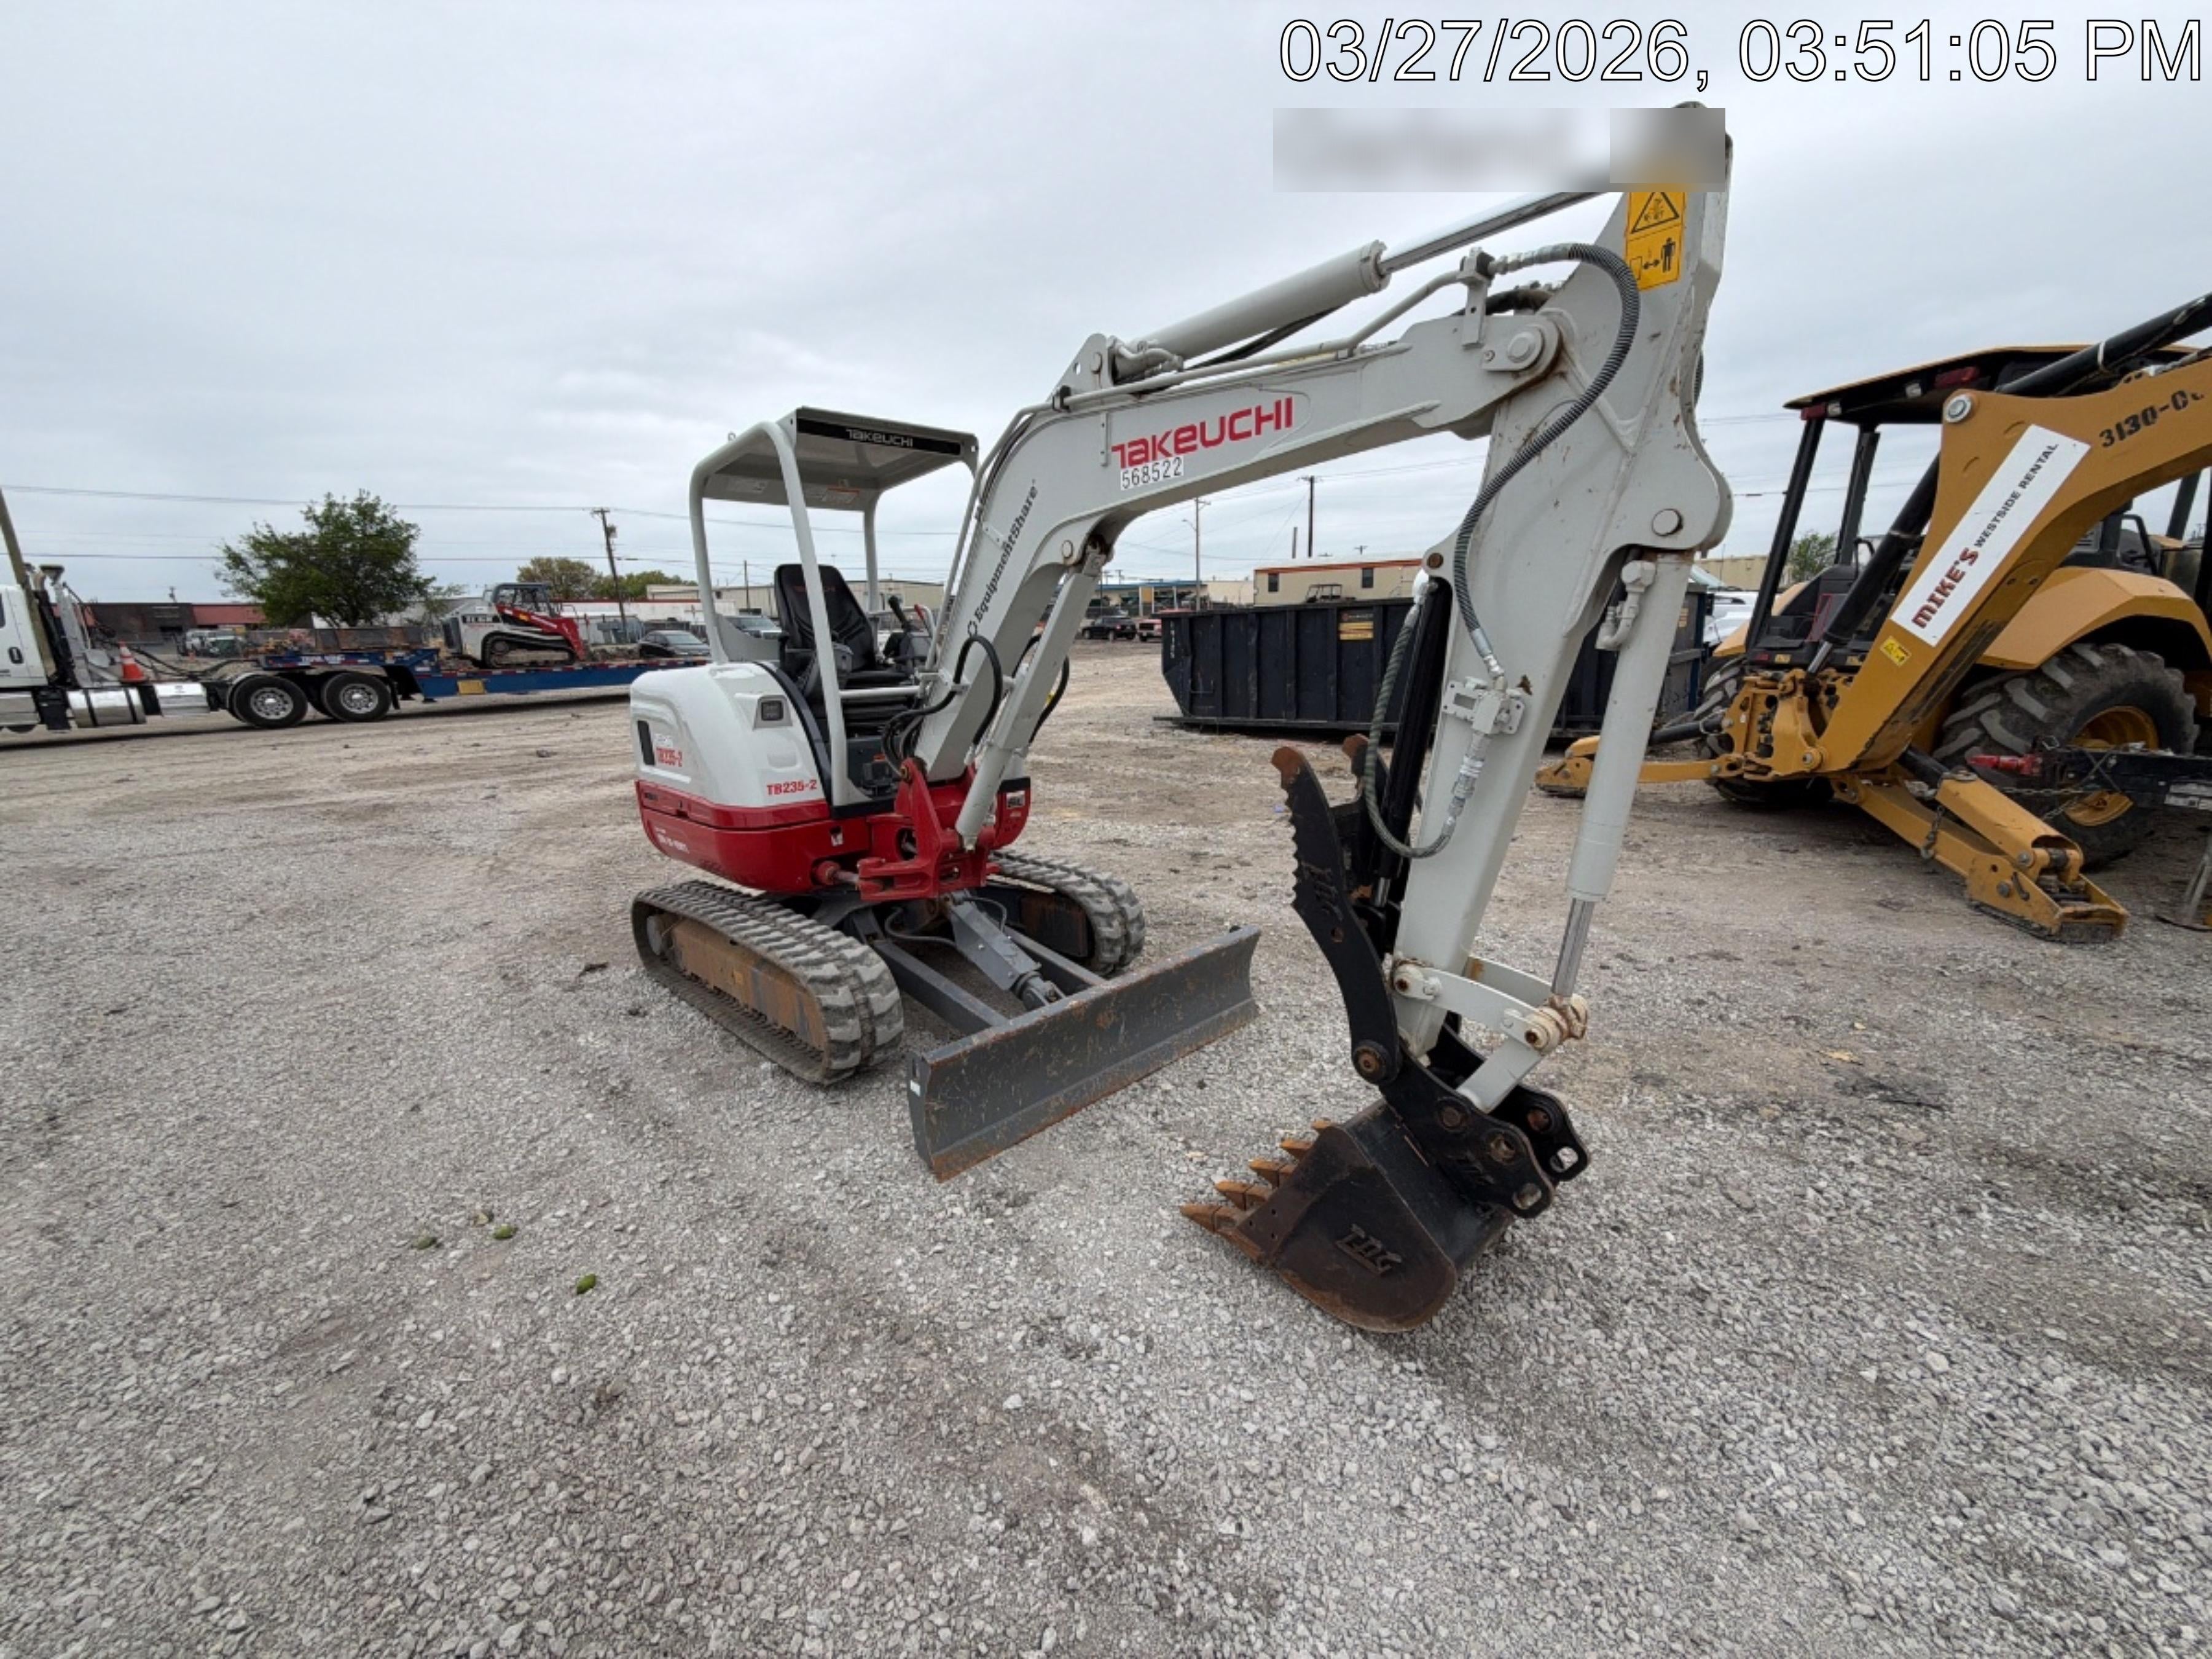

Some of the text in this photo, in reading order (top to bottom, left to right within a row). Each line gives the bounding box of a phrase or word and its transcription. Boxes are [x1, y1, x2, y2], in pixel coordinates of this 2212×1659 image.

[1112, 397, 1293, 469] TAKEUCHI
[1121, 457, 1182, 490] 568522
[975, 484, 1038, 623] EquipmentShare
[1912, 442, 2059, 630] MIKE'S WESTSIDE RENTAL
[766, 779, 817, 796] TB235-2
